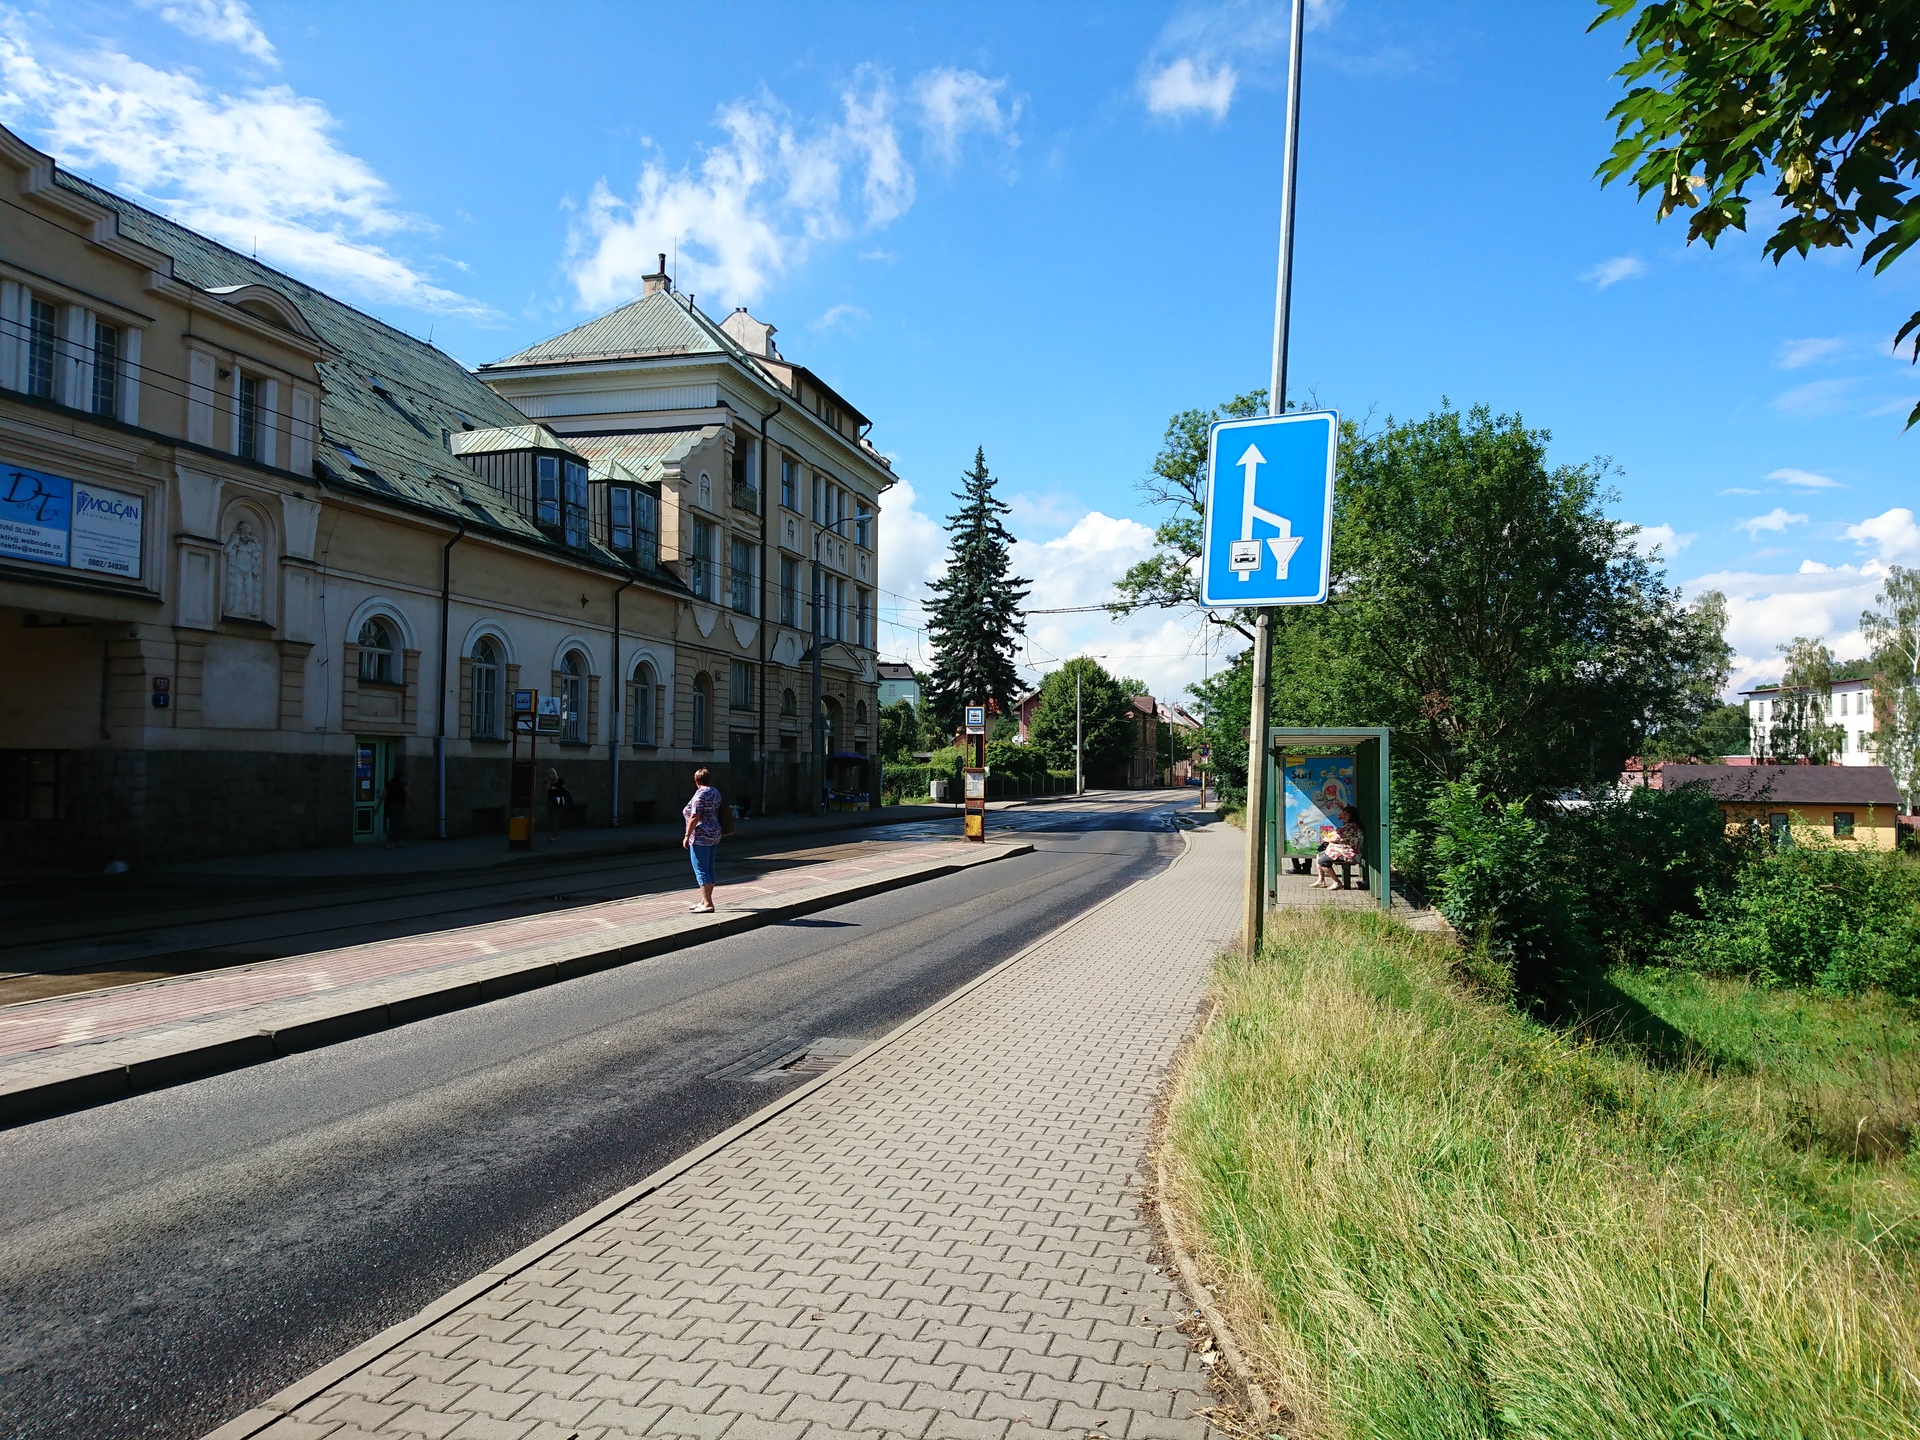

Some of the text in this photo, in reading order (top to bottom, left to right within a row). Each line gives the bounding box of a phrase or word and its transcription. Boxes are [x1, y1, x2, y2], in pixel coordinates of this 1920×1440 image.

[83, 497, 138, 519] MOLČAN
[15, 526, 41, 537] SLUŽBY
[0, 533, 61, 550] ktivjj.webnode.cz
[160, 695, 164, 705] 1
[1292, 770, 1313, 779] Surf
